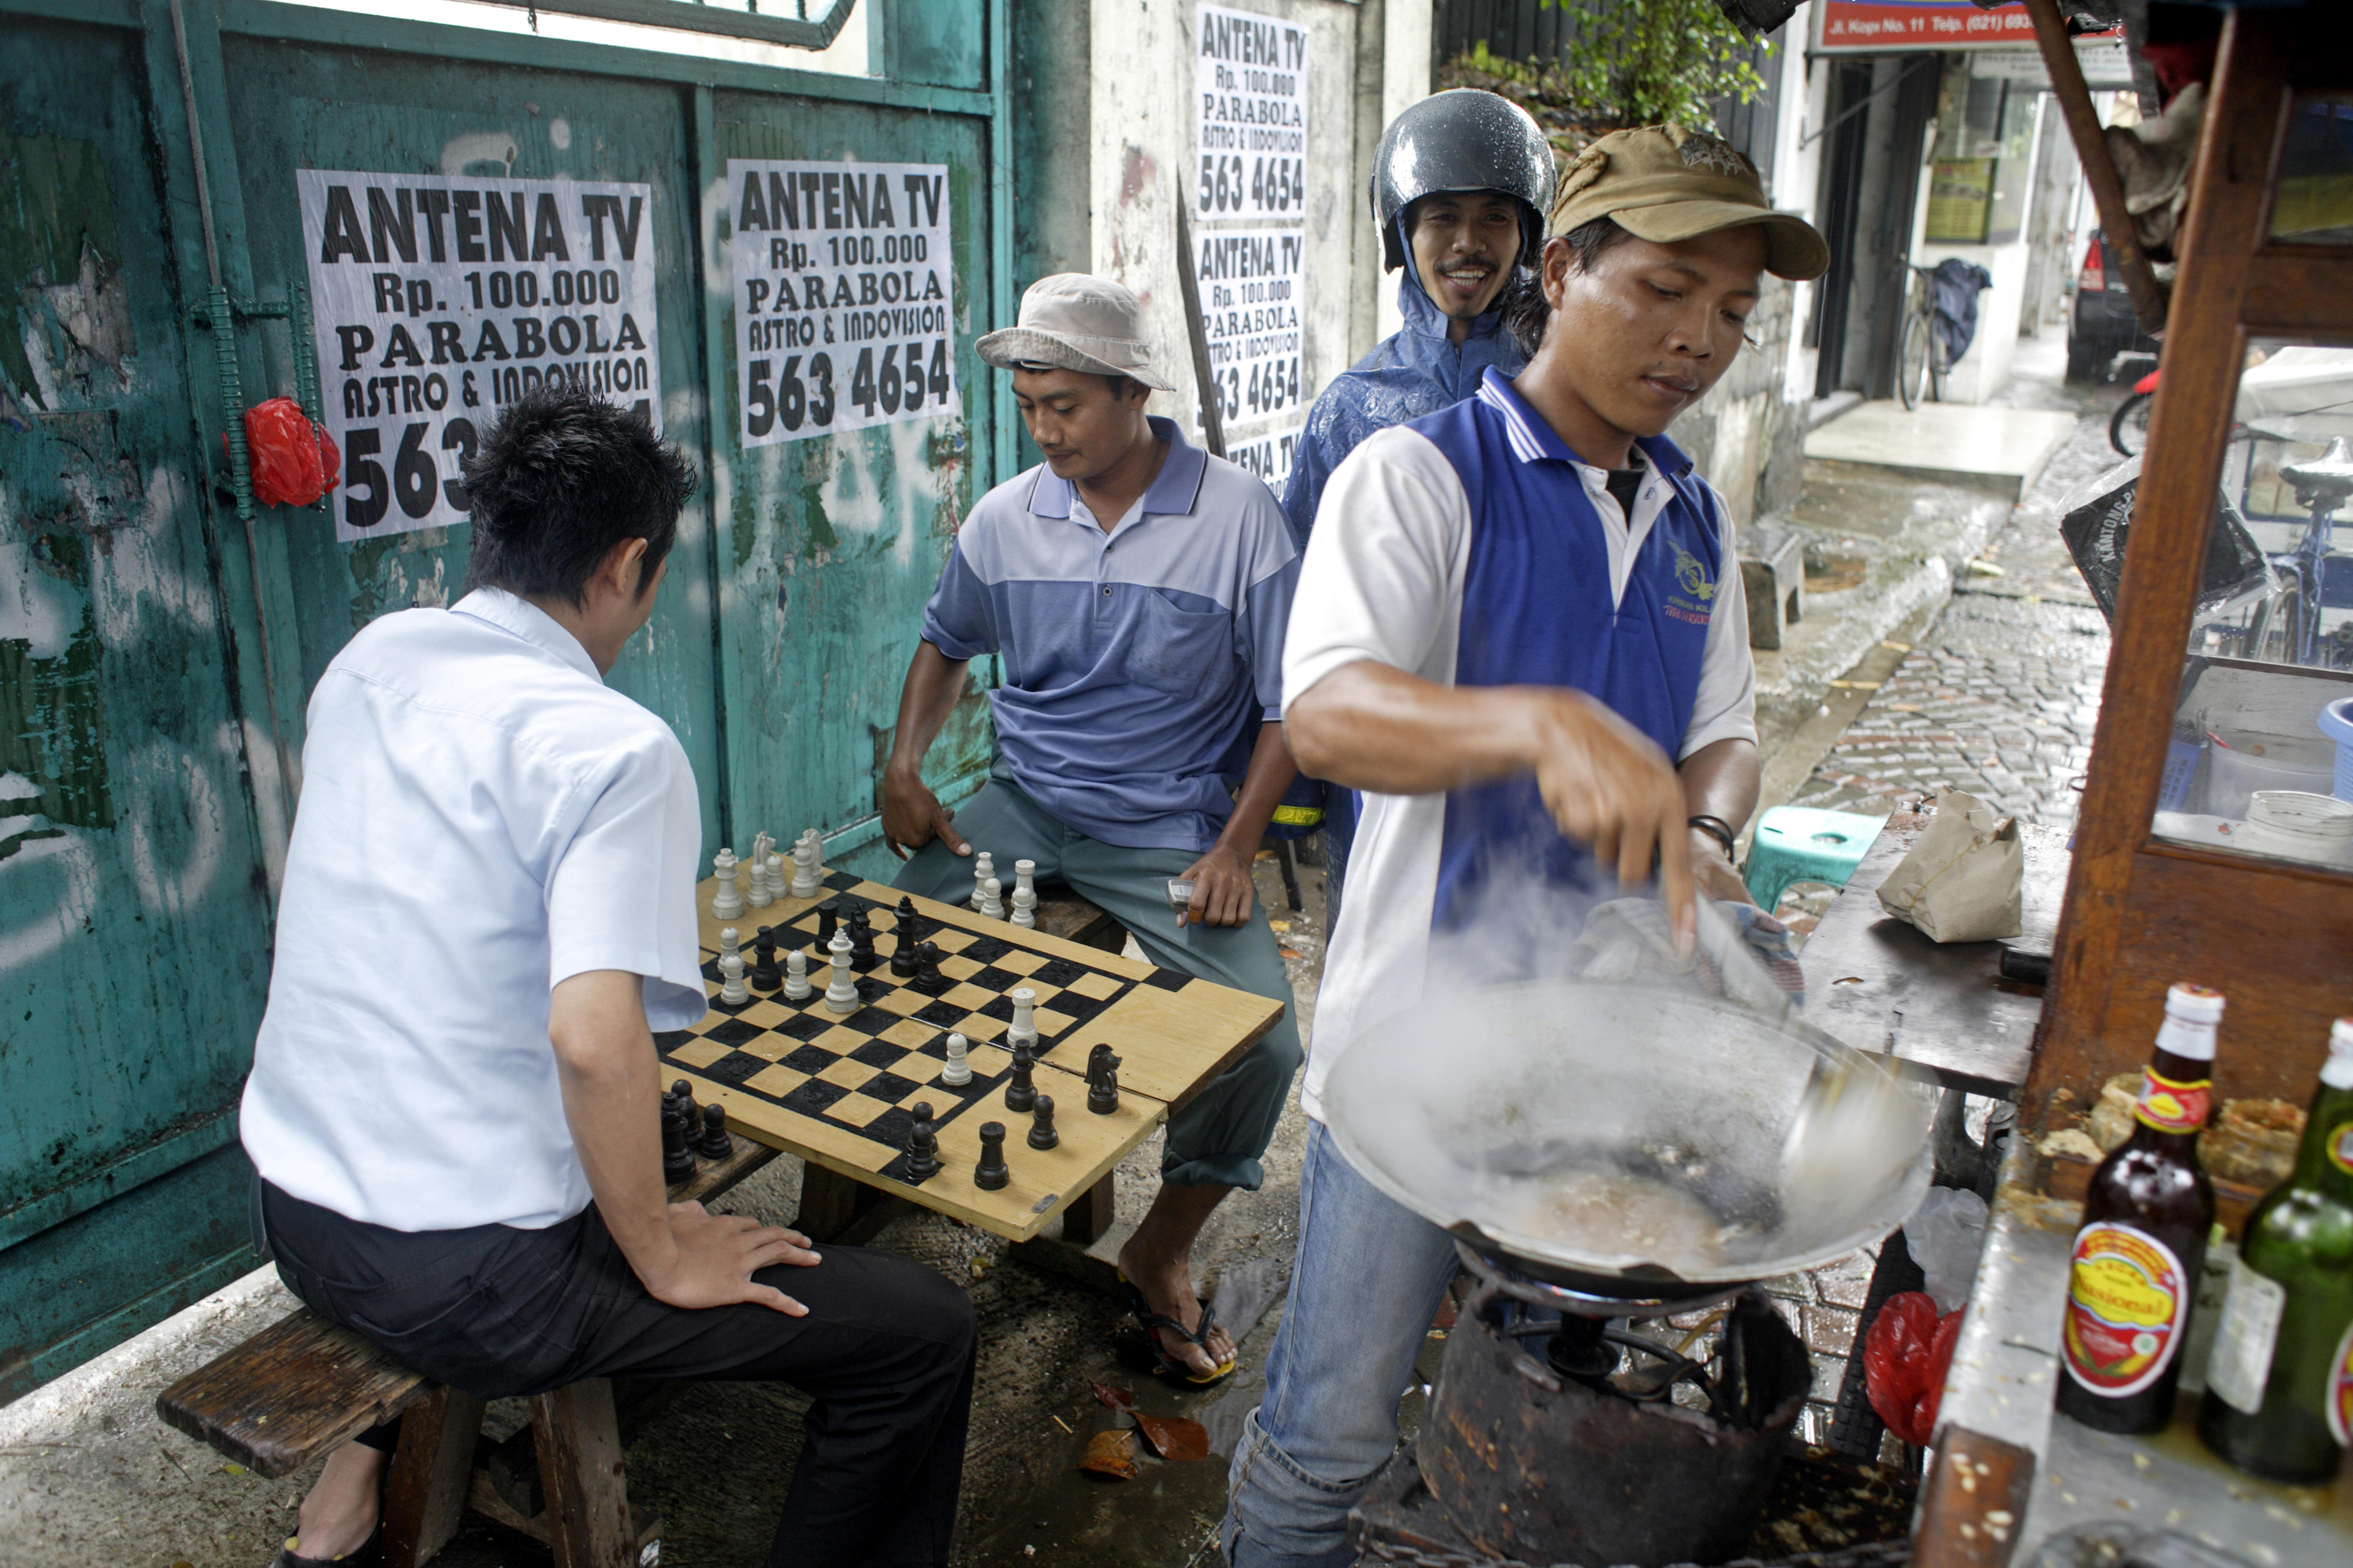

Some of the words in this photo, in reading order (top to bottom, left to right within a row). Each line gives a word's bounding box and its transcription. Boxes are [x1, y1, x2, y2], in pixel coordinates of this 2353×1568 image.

[1201, 12, 1279, 67] ANTENA
[1285, 28, 1307, 71] TV
[1909, 16, 1924, 32] 11
[1932, 15, 1964, 34] Telp.
[1966, 14, 2003, 34] (021)
[1216, 64, 1238, 92] Rp.
[1244, 69, 1295, 97] 100.000
[1203, 94, 1302, 127] PARABOLA
[1203, 125, 1235, 149] ASTRO
[739, 171, 895, 232] ANTENA
[904, 174, 943, 228] TV
[1199, 154, 1243, 212] 563
[1251, 156, 1302, 212] 4654
[321, 186, 570, 263] ANTENA
[582, 194, 644, 261] TV
[770, 238, 816, 272] Rp.
[828, 234, 927, 267] 100.000
[1199, 236, 1275, 281] ANTENA
[1281, 235, 1302, 275] TV
[372, 273, 447, 317] Rp.
[464, 269, 619, 309] 100.000
[745, 269, 944, 315] PARABOLA
[1213, 285, 1235, 309] Rp.
[1241, 279, 1291, 304] 100.000
[335, 313, 646, 371] PARABOLA
[749, 316, 815, 352] ASTRO
[824, 313, 835, 345] &
[844, 305, 944, 342] INDOVISION
[343, 372, 449, 418] ASTRO
[462, 369, 481, 407] &
[748, 352, 835, 437] 563
[851, 339, 949, 418] 4654
[1197, 366, 1239, 428] 63
[1247, 356, 1298, 415] 4654
[345, 416, 478, 527] 563
[1280, 433, 1299, 473] TV
[2099, 500, 2127, 562] KANTONG
